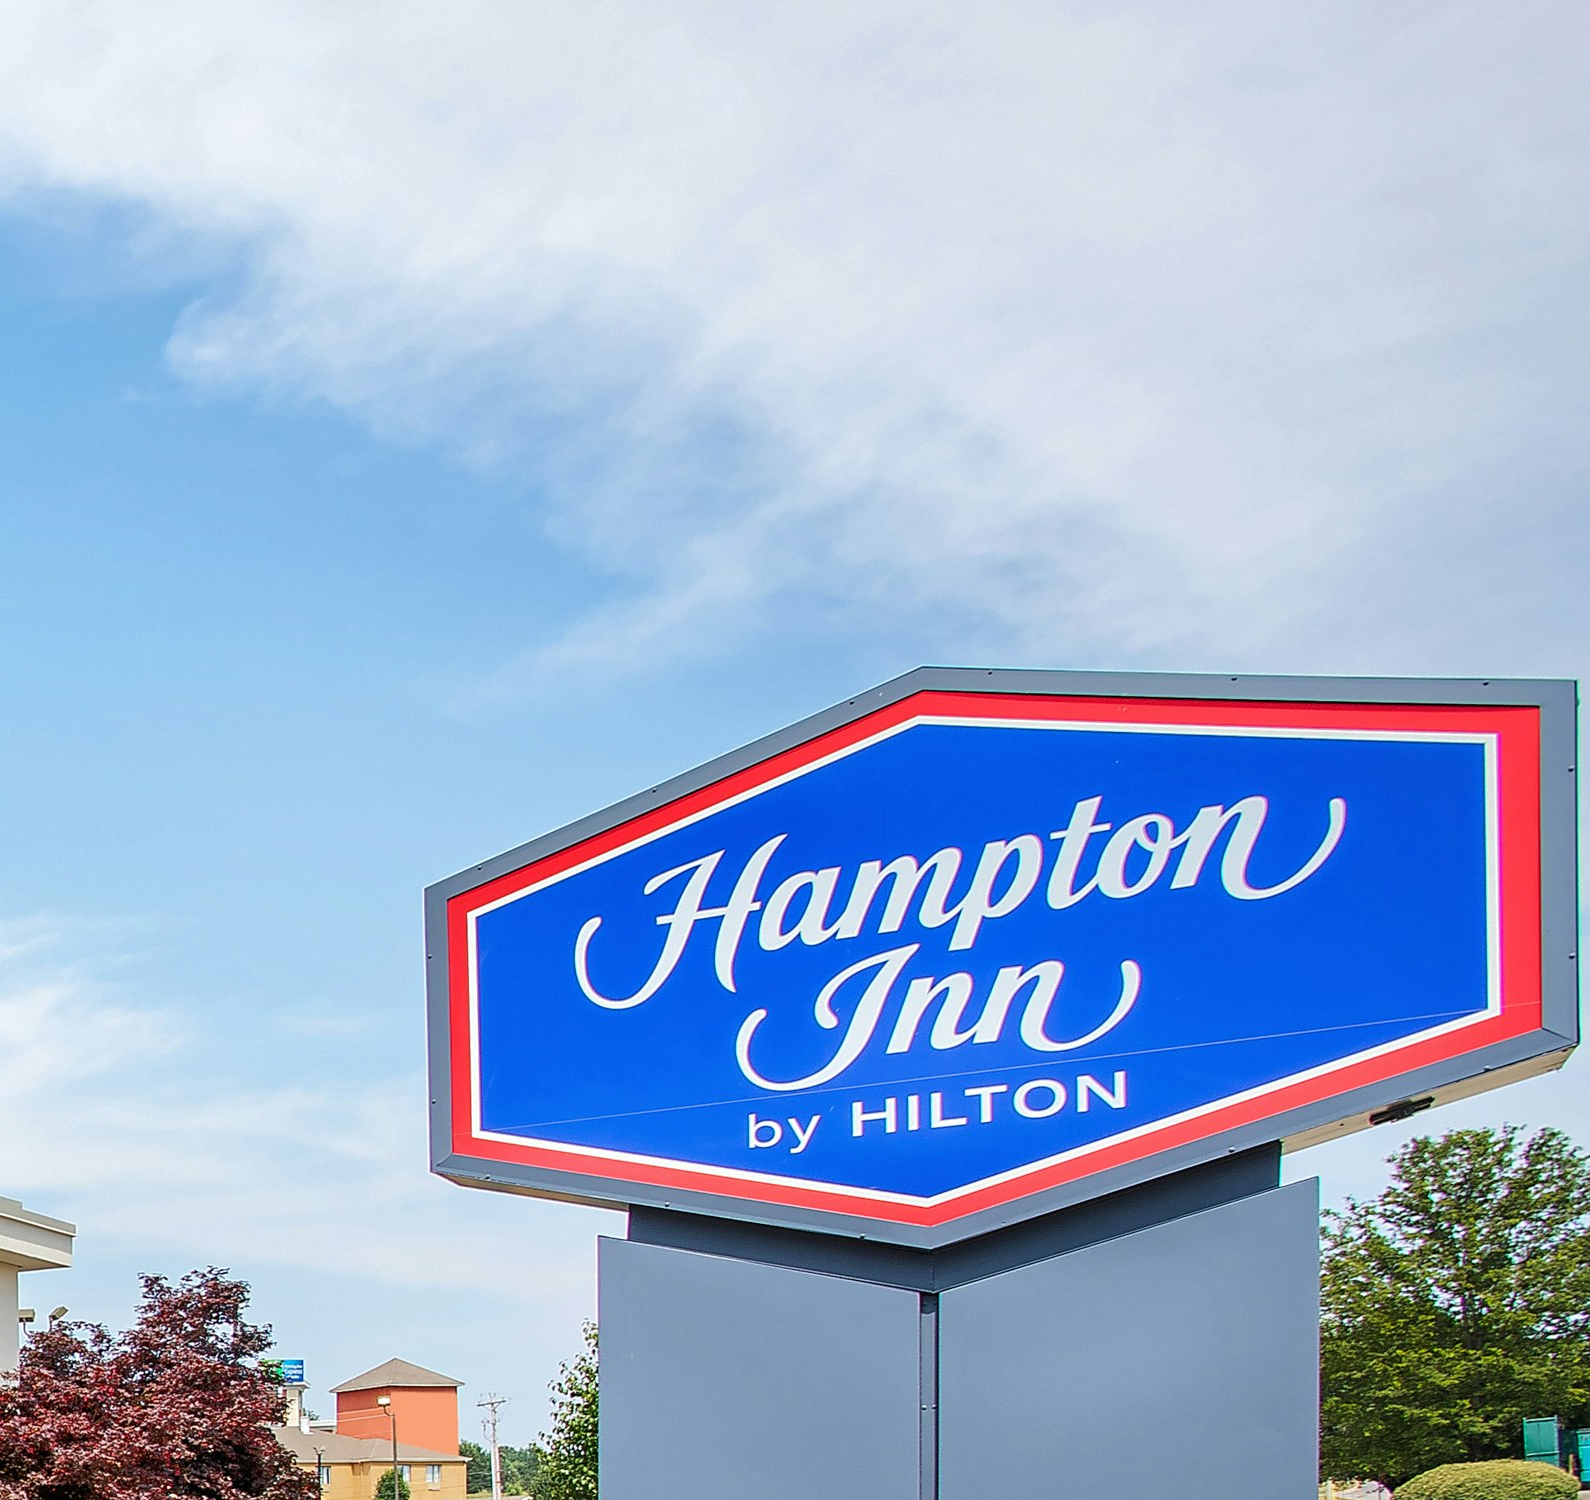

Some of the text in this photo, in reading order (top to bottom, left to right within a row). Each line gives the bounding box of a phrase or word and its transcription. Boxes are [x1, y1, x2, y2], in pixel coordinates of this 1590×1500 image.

[574, 794, 1347, 1010] Hampton
[736, 943, 1141, 1092] Inn
[748, 1070, 1127, 1154] by HILTON
